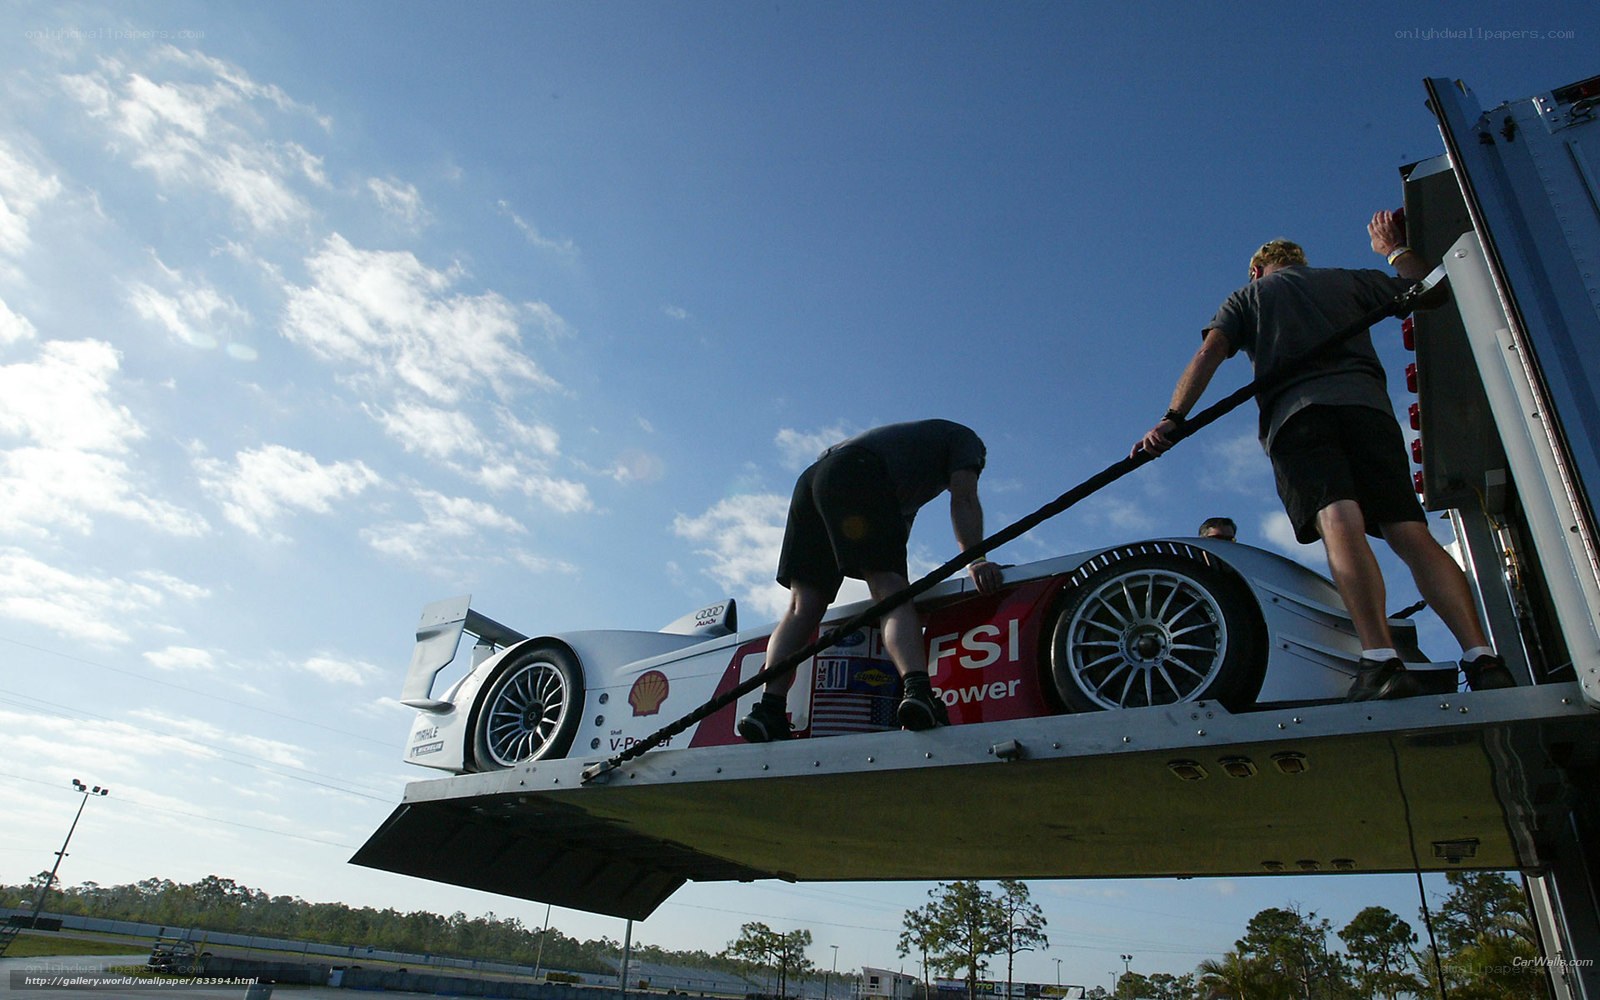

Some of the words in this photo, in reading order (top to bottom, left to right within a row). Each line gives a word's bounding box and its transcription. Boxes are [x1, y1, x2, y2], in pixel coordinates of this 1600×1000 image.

[695, 618, 717, 627] Audi
[927, 618, 1019, 678] FSI
[817, 660, 827, 689] IMSA
